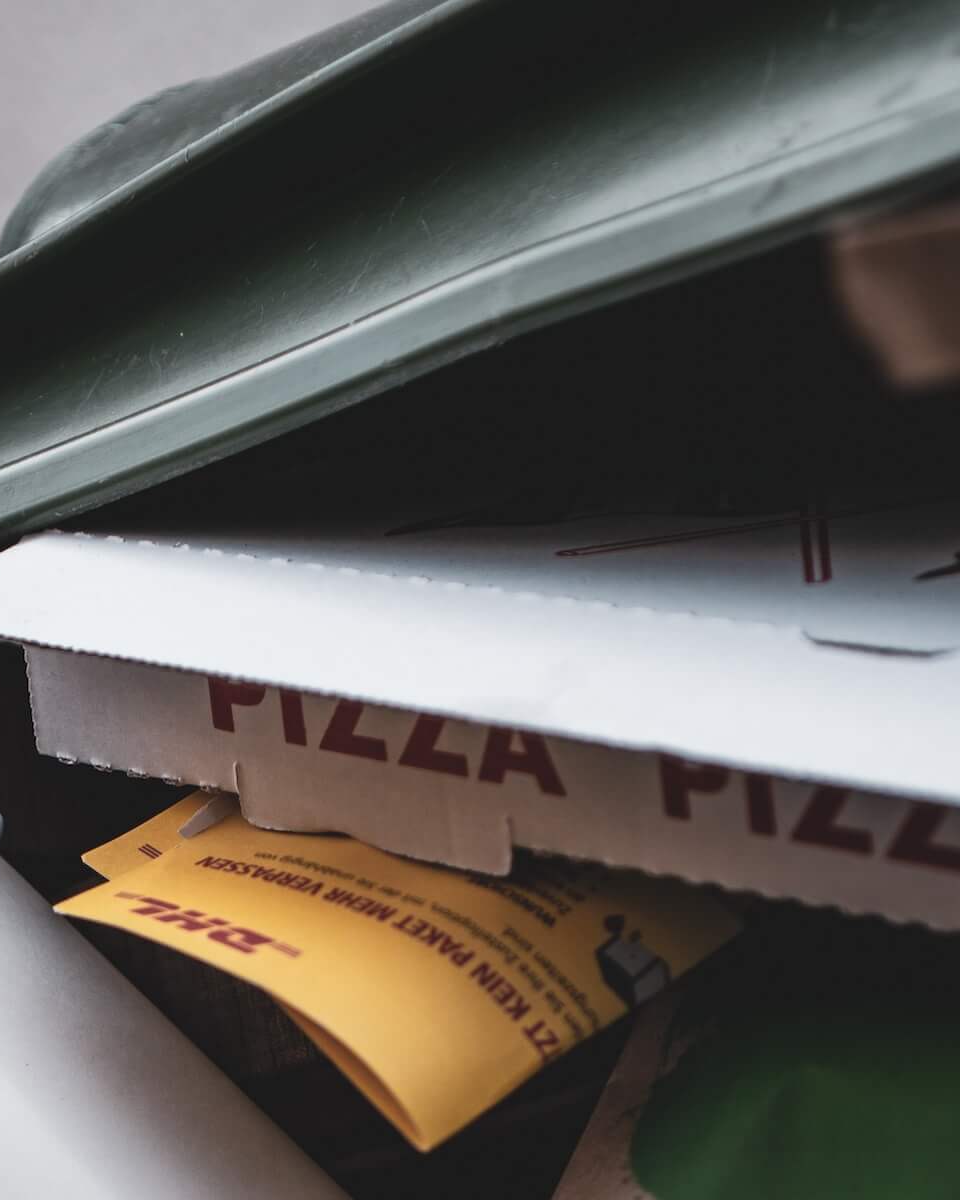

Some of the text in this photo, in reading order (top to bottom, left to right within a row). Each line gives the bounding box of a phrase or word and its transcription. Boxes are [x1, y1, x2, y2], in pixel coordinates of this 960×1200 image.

[208, 676, 567, 796] PIZZA
[193, 856, 324, 896] VERPASSEN
[322, 887, 399, 922] MEHR
[126, 894, 282, 956] DHL
[391, 913, 474, 967] PAKET
[470, 962, 532, 1022] KEIN
